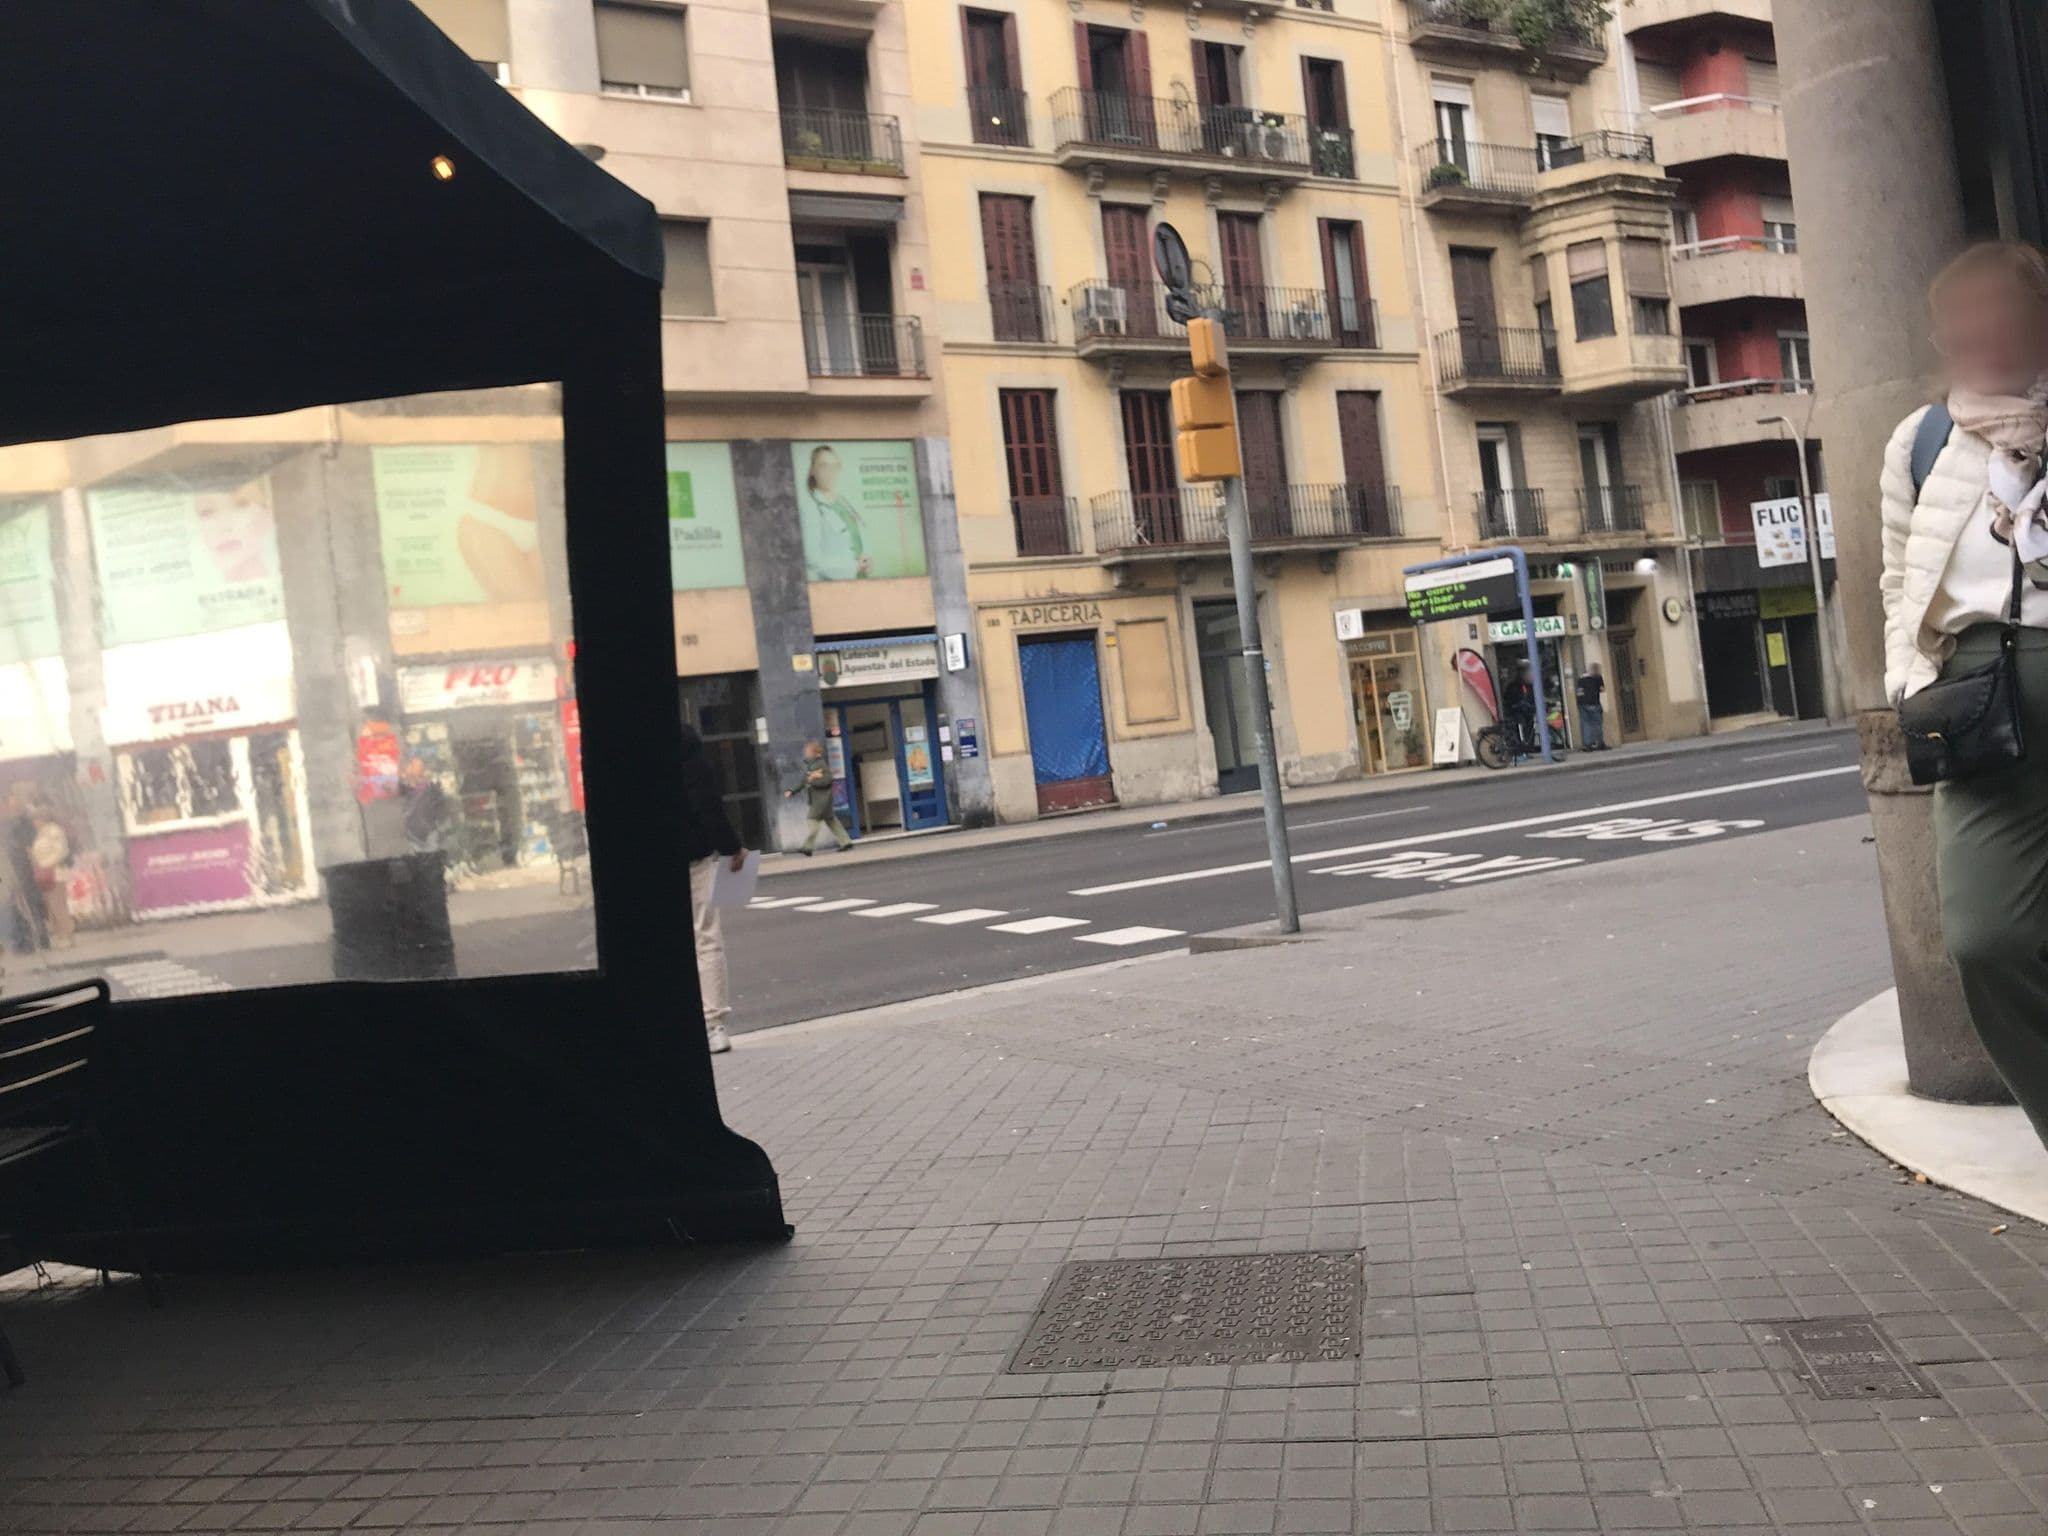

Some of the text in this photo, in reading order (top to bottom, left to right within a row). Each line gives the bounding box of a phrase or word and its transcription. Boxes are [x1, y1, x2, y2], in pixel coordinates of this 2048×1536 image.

[1756, 504, 1800, 527] FLIC
[1008, 601, 1103, 626] TAPICERIA
[844, 662, 886, 676] Apuestas
[888, 659, 904, 670] del
[905, 655, 936, 668] Estado
[149, 695, 241, 725] TIZANA
